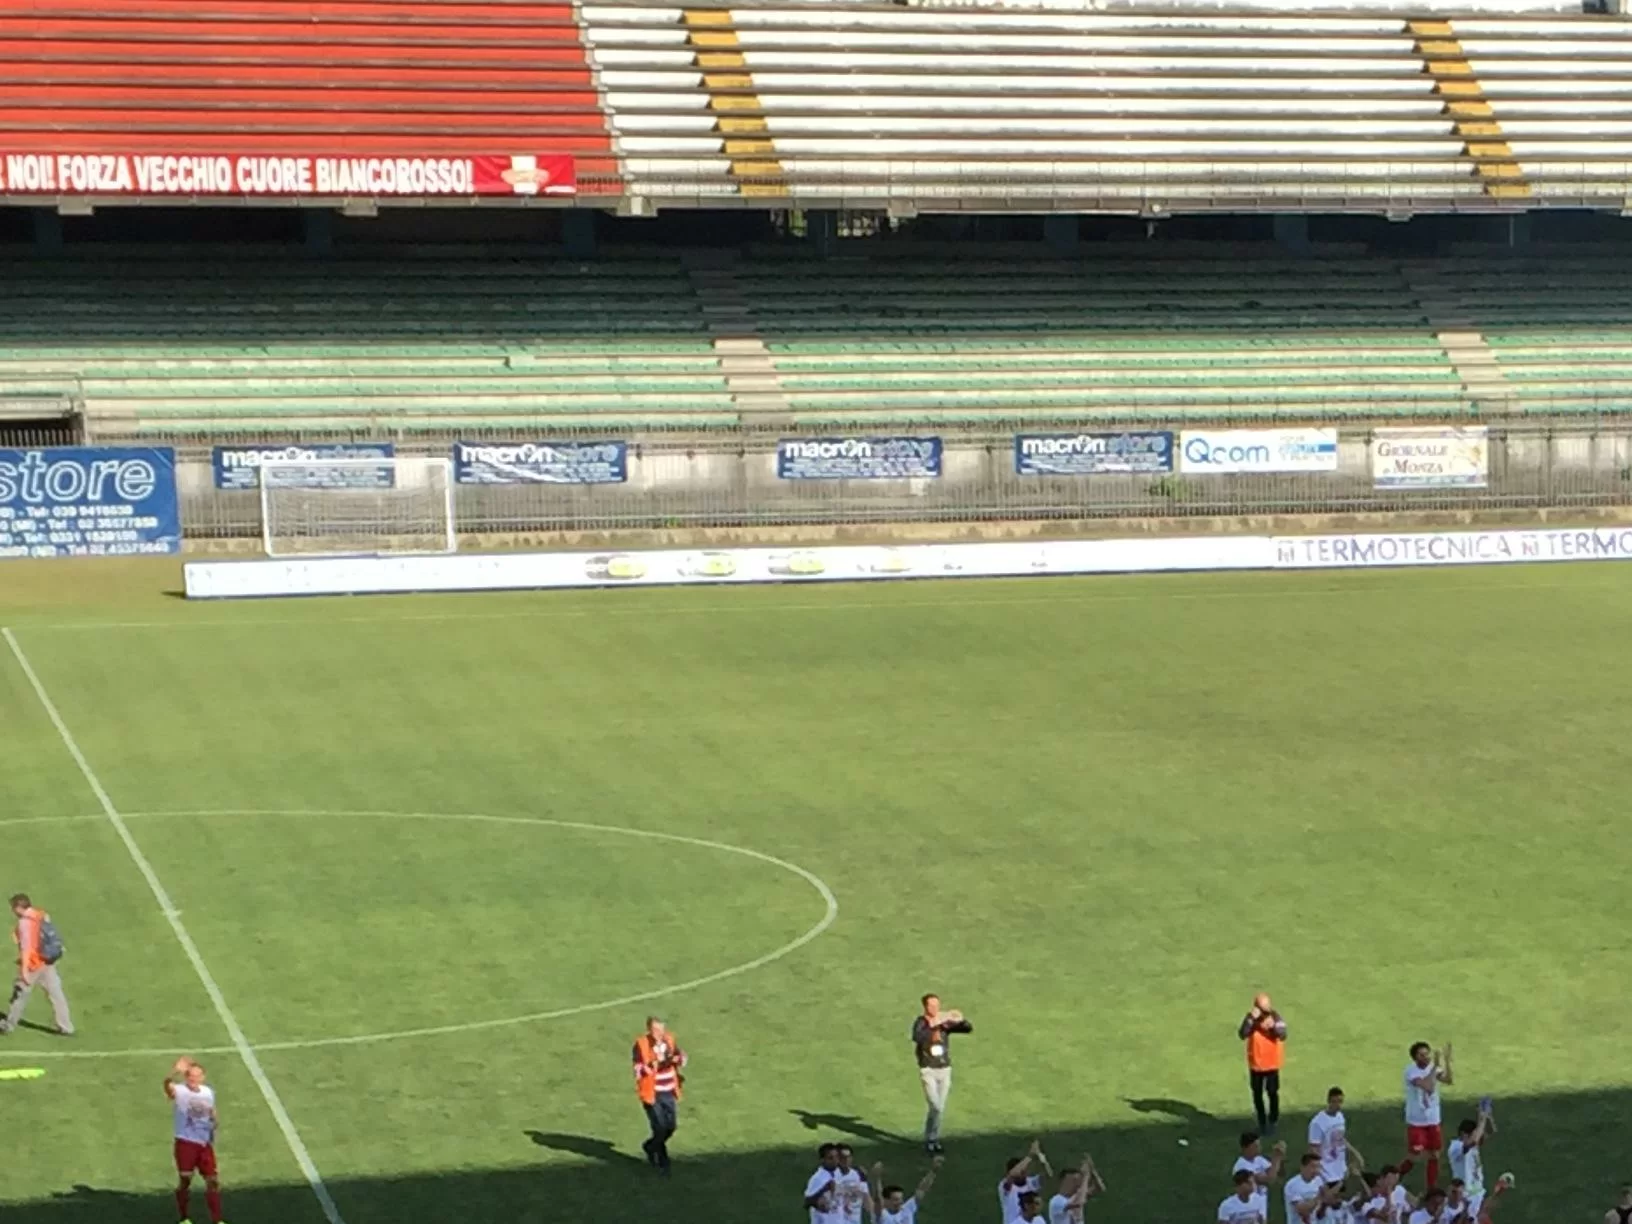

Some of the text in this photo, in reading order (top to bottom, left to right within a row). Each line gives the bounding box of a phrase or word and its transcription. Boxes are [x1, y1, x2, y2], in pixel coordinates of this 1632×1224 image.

[7, 154, 55, 190] NOI!
[57, 155, 133, 190] FORZA
[133, 155, 232, 192] VECCHIO
[236, 156, 312, 193] CUORE
[315, 157, 474, 194] BIANCOROSSO!
[1185, 437, 1270, 465] Qcom
[1303, 533, 1511, 563] TERMOTECNICA
